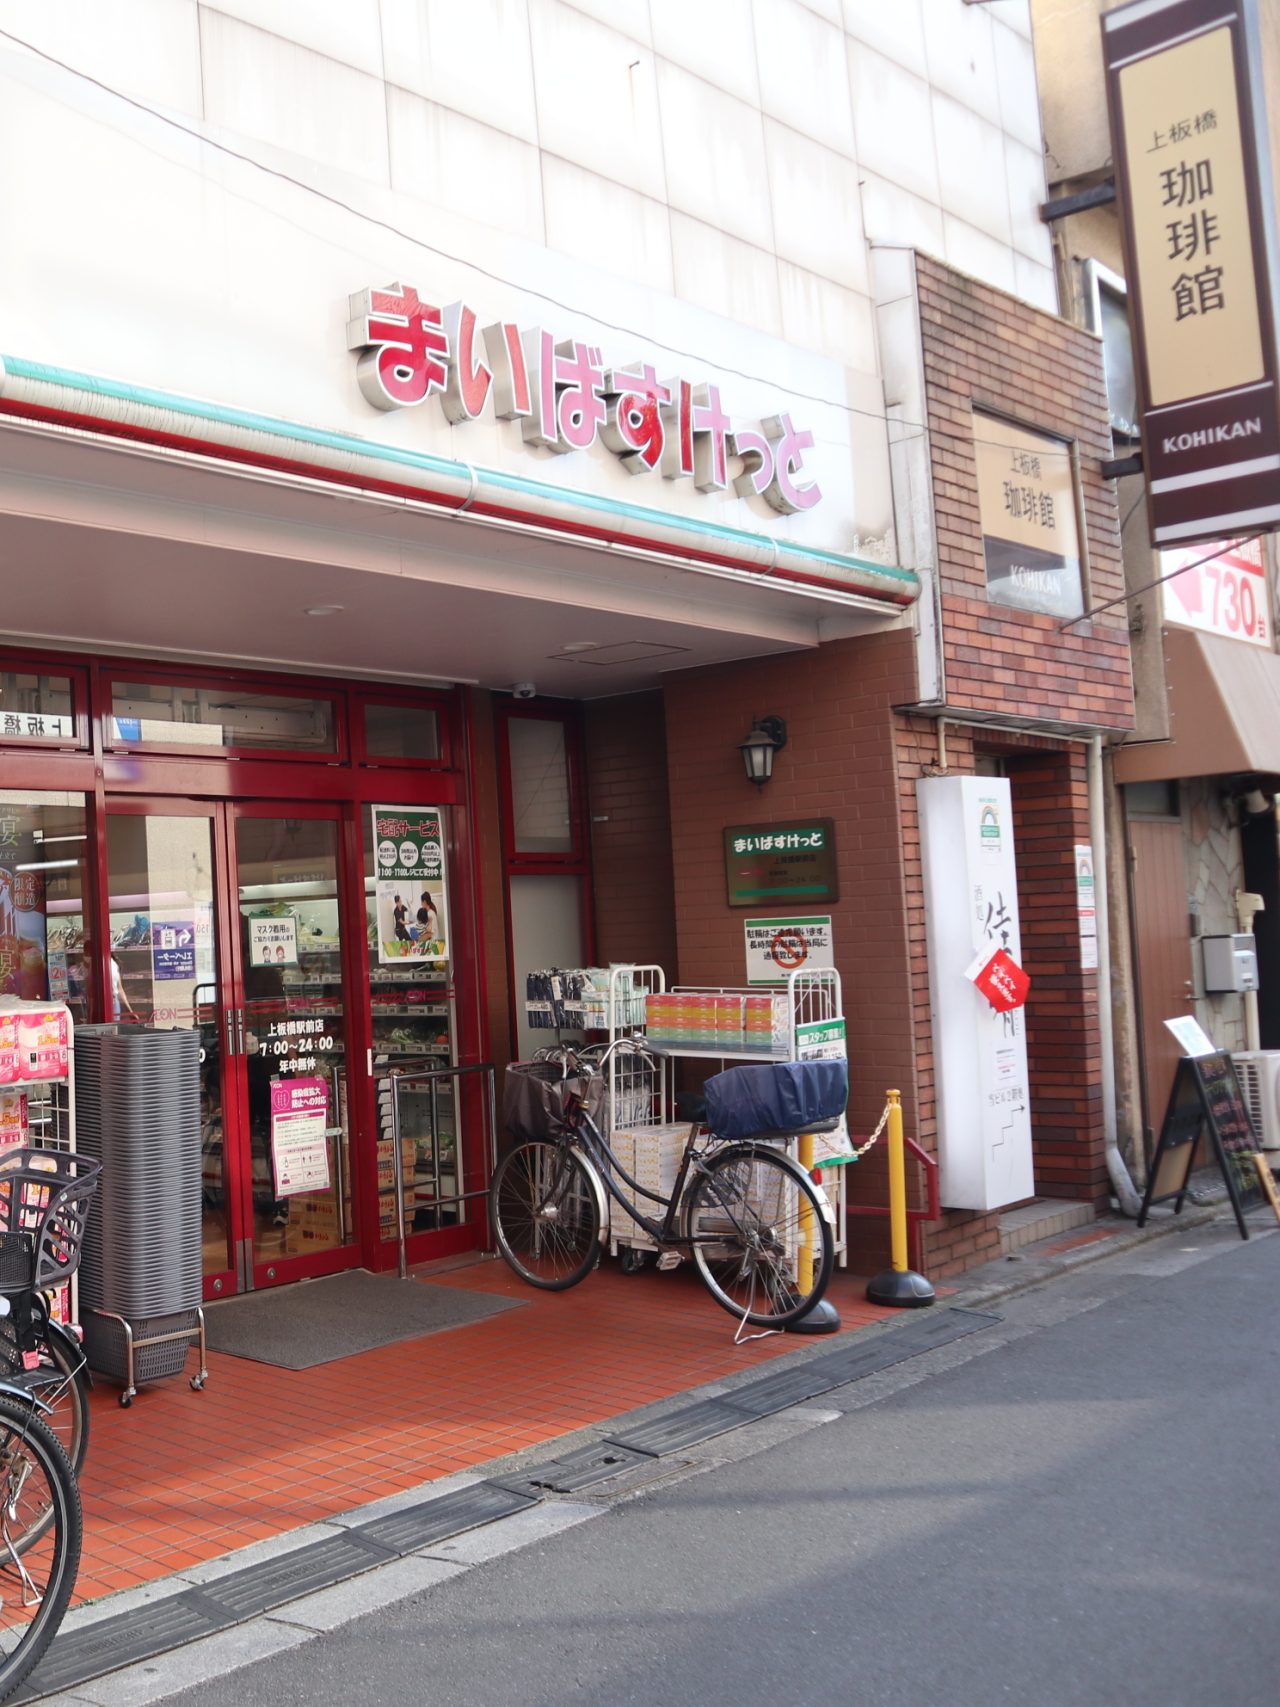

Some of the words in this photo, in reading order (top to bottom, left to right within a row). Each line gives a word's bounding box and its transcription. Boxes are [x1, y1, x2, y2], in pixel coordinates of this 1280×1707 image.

[1145, 108, 1218, 153] 上板橋
[1160, 159, 1225, 323] 珈琲館
[360, 283, 822, 513] まいばすけっと
[1163, 418, 1261, 454] KOHIKAN
[1010, 451, 1042, 481] 上板橋
[1003, 481, 1056, 531] 珈琲館
[1010, 565, 1061, 596] KOHIKAN
[377, 818, 440, 838] 宅配サービス
[734, 832, 823, 853] まいばすけっと
[267, 1019, 324, 1037] 上板橋駅前店
[279, 1057, 317, 1074] 年中無休
[291, 1095, 327, 1109] 防止への対応
